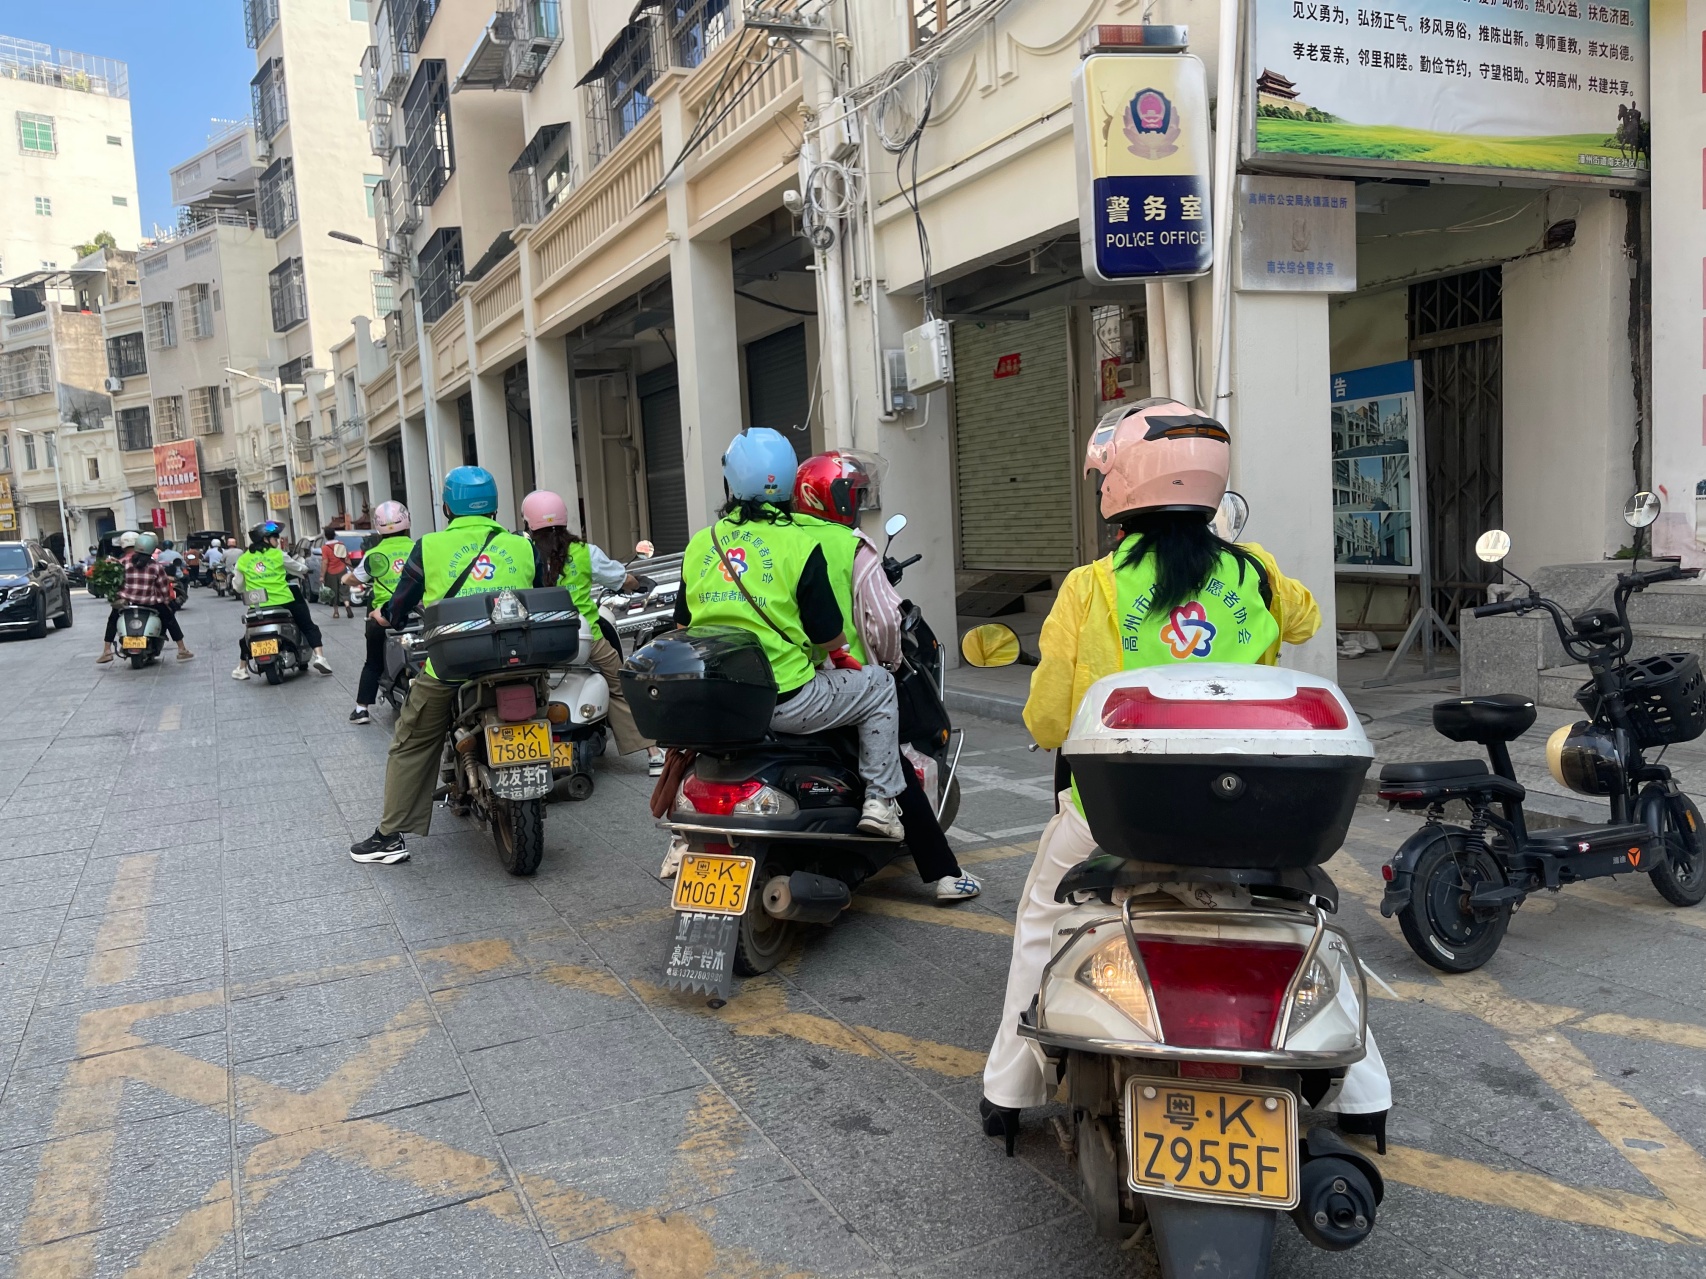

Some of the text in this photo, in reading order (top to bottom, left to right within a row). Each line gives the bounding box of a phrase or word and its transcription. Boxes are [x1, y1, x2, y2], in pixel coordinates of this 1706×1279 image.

[1106, 195, 1204, 223] 警务室
[1106, 231, 1208, 248] POLICE OFFICE
[1333, 377, 1347, 398] 告
[494, 740, 549, 762] 7586L
[495, 764, 548, 787] 龙发车行
[1143, 1131, 1280, 1192] Z955F
